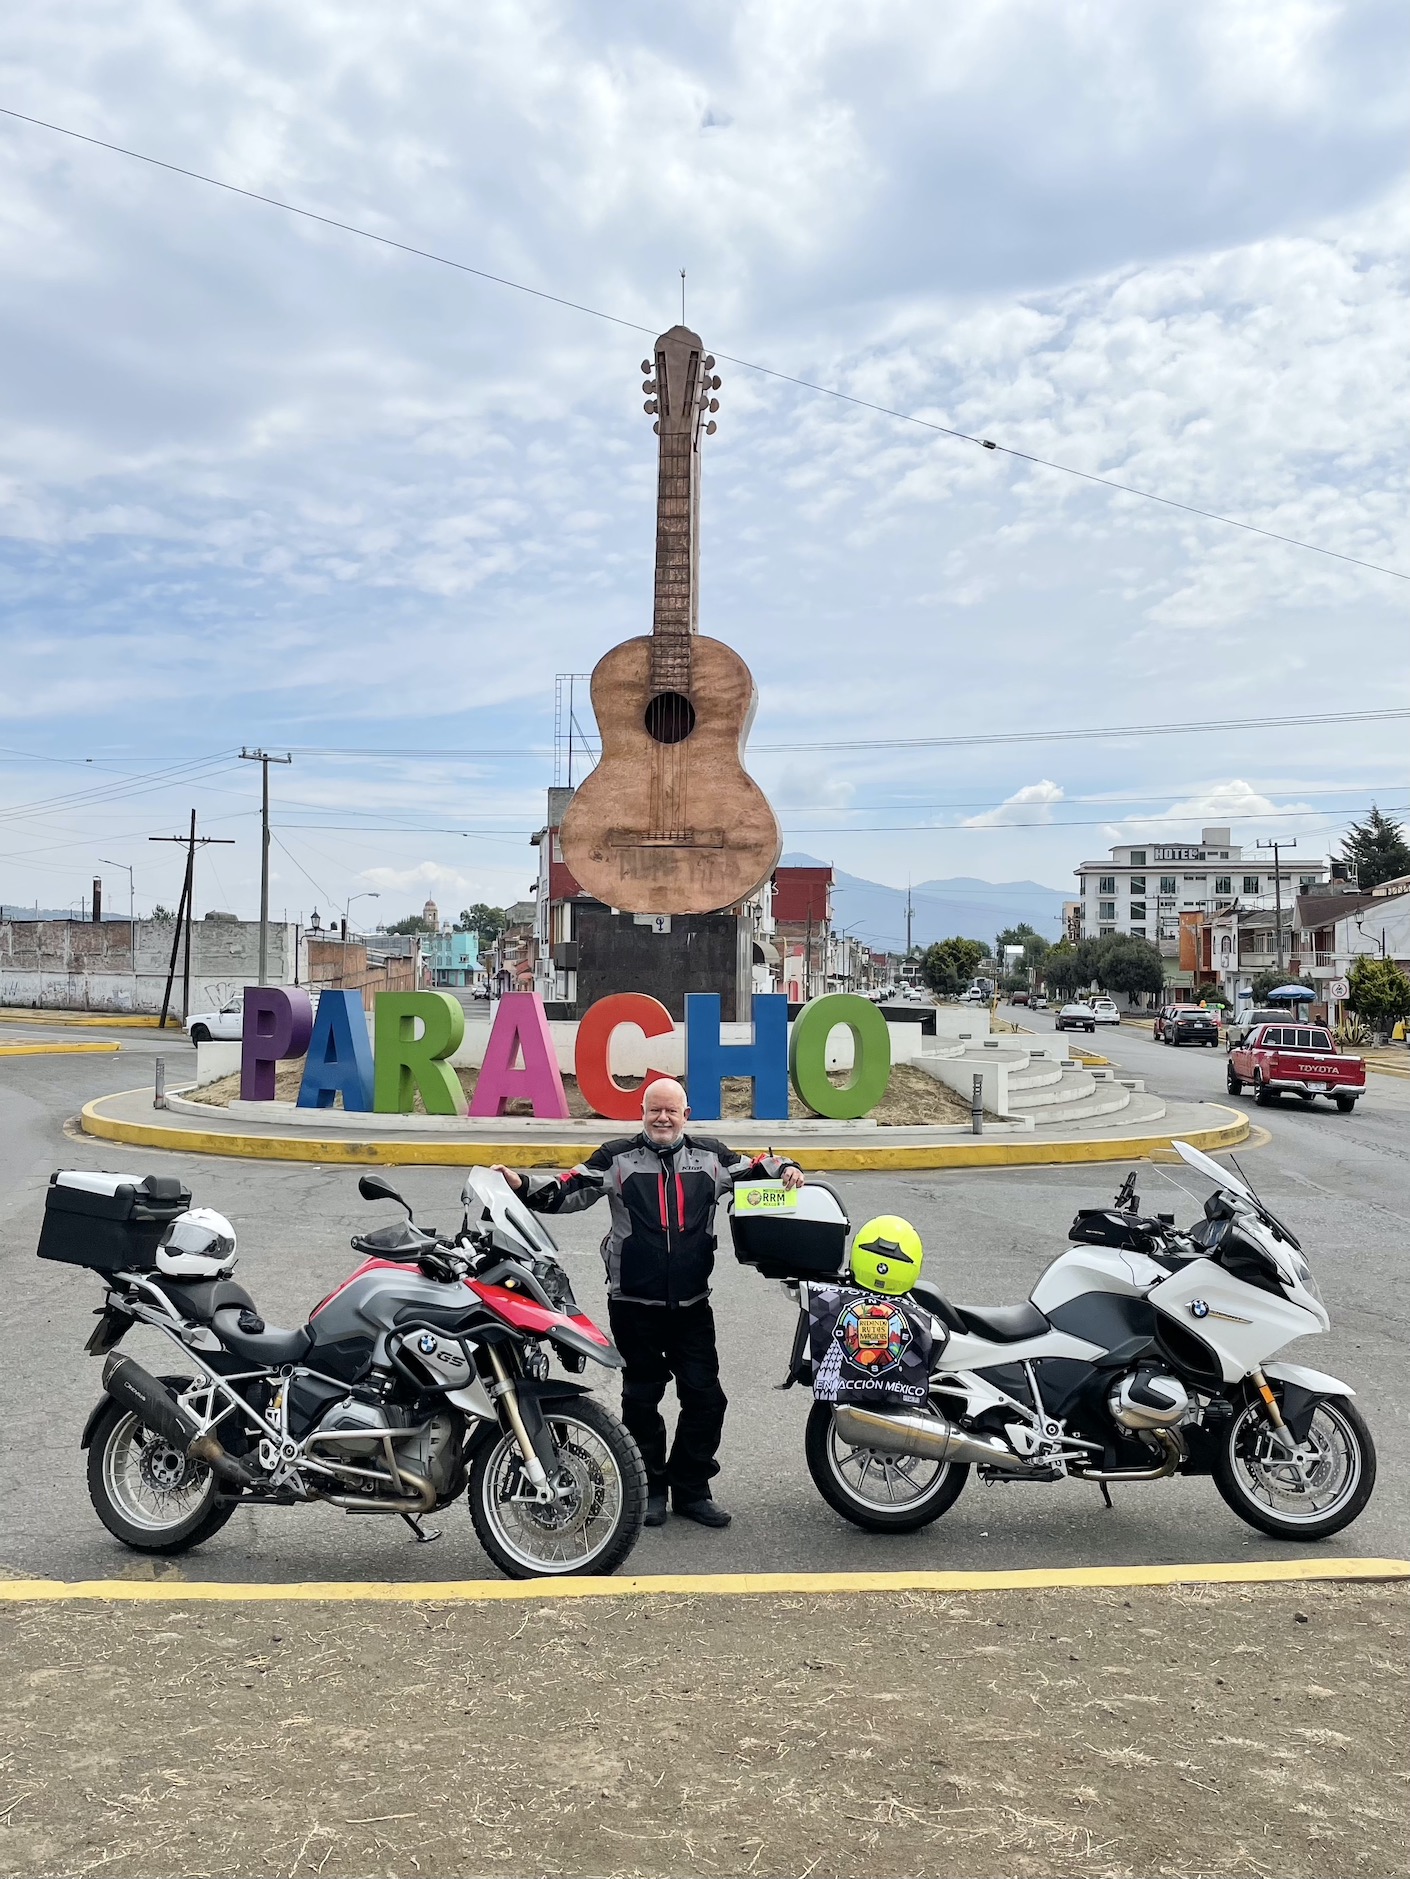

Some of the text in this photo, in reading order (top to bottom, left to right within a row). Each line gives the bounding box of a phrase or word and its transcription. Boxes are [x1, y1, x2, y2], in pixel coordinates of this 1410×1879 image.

[1154, 848, 1197, 860] HOTEL
[241, 986, 892, 1120] PARACHO
[1298, 1064, 1340, 1075] TOYOTA
[763, 1192, 785, 1202] RRM
[437, 1351, 466, 1367] GS
[816, 1378, 925, 1396] EN ACCIÓN MÉXICO
